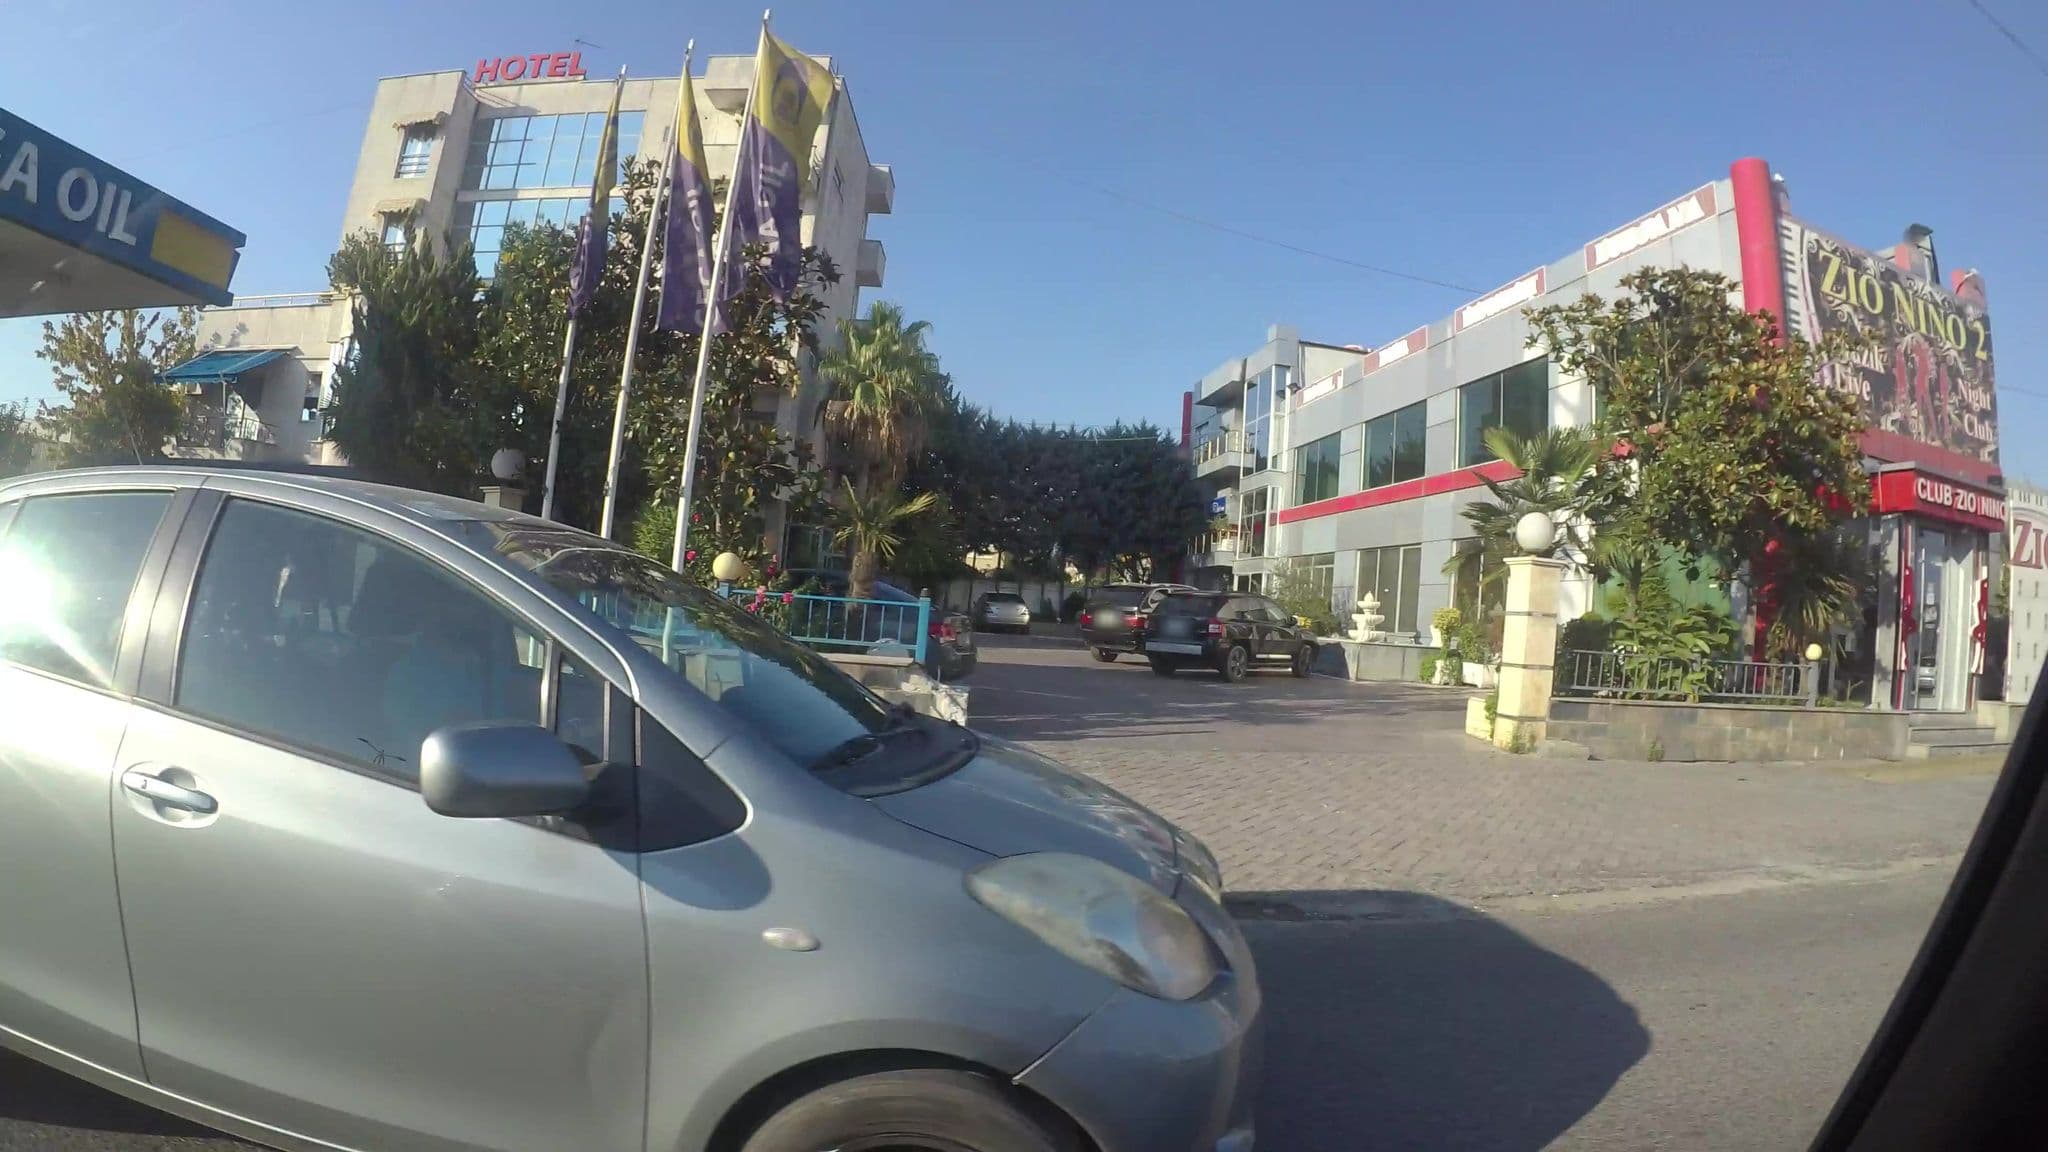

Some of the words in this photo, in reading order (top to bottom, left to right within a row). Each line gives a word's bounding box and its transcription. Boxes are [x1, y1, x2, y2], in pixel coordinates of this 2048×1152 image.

[474, 51, 587, 83] HOTEL
[57, 167, 137, 246] OIL
[1818, 249, 1884, 315] ZIO
[1890, 281, 1967, 350] NINO
[1969, 319, 1988, 361] 2
[1957, 377, 1992, 412] Night
[1964, 413, 1993, 441] Club
[1917, 477, 1953, 506] CLUB
[1954, 488, 1977, 513] ZIO
[1978, 496, 2007, 520] NINO
[2008, 519, 2048, 570] ZI
